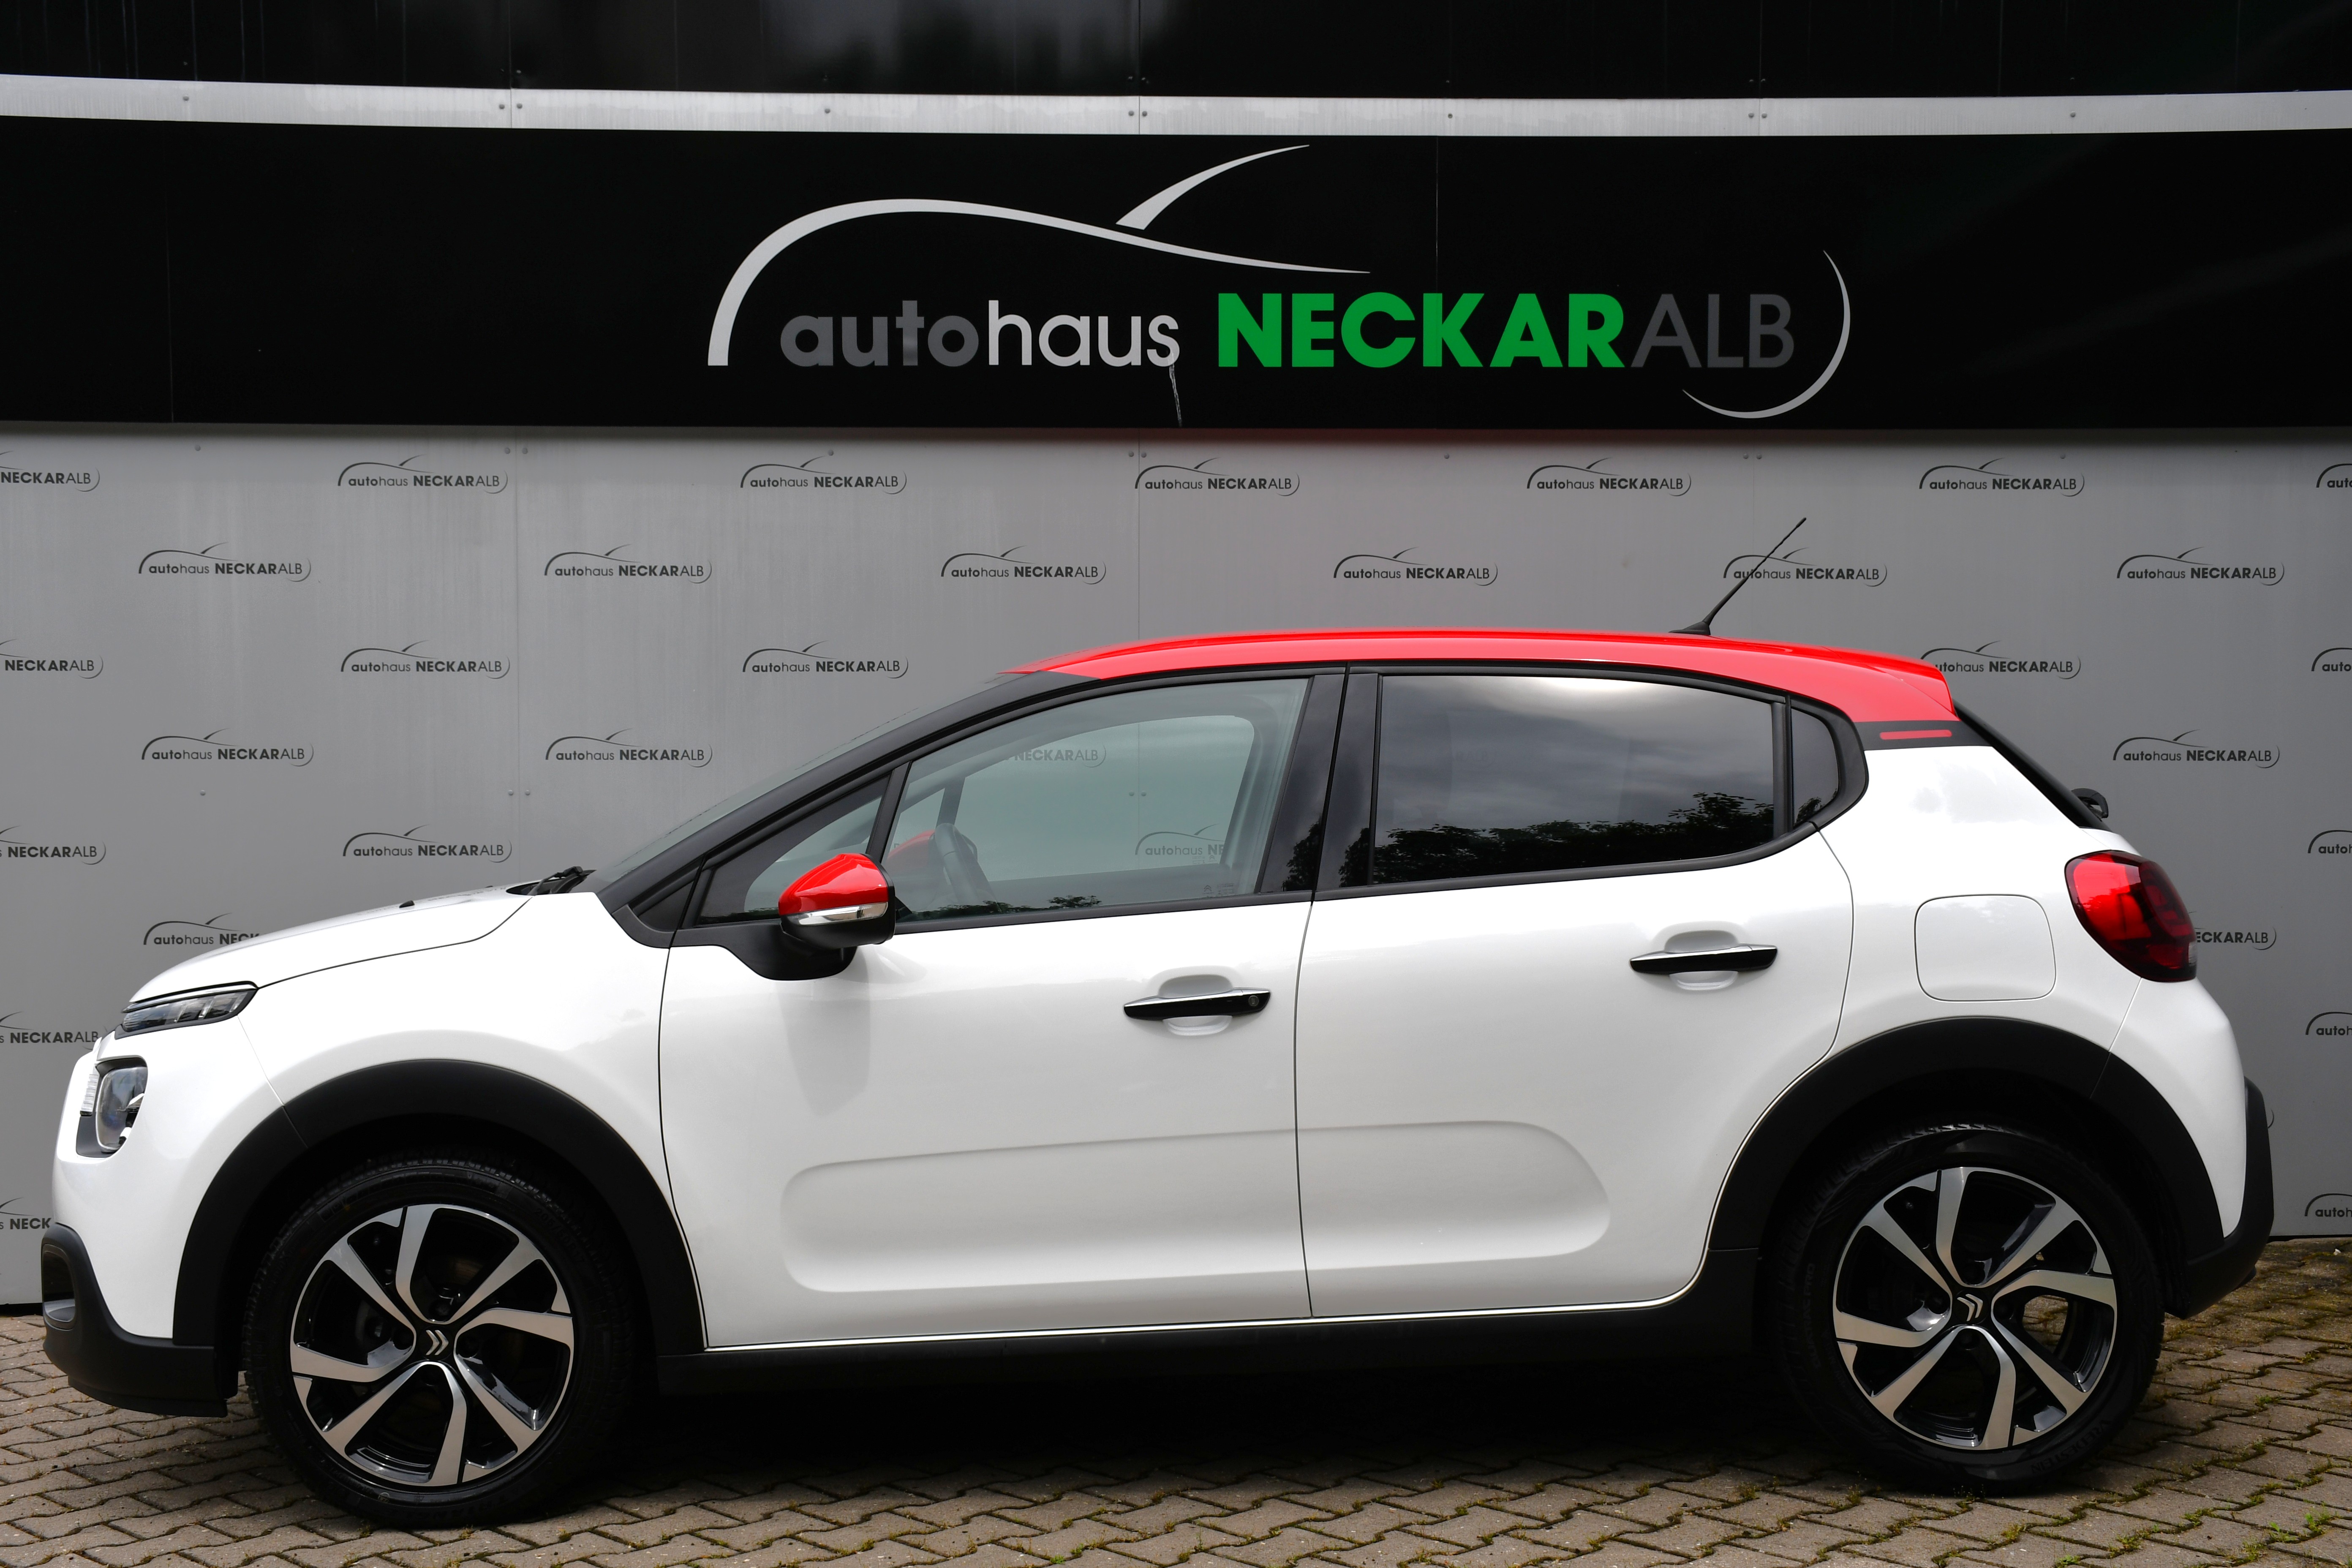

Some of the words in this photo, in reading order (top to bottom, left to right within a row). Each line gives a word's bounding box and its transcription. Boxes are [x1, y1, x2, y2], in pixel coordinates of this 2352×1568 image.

[780, 299, 1180, 368] autohaus
[1218, 291, 1794, 368] NECKARALB
[1, 471, 91, 484] NECKARALB
[348, 476, 408, 486] autohaus
[413, 475, 500, 487] NECKARALB
[749, 477, 808, 487] autohaus
[814, 476, 898, 487] NECKARALB
[1145, 479, 1203, 489] autohaus
[1208, 478, 1292, 489] NECKARALB
[1537, 479, 1595, 489] autohaus
[1600, 478, 1683, 490] NECKARALB
[1929, 479, 1987, 490] autohaus
[1992, 478, 2077, 490] NECKARALB
[149, 564, 210, 574] autohaus
[215, 563, 302, 574] NECKARALB
[555, 566, 613, 576] autohaus
[619, 565, 704, 577] NECKARALB
[951, 567, 1009, 577] autohaus
[1014, 566, 1098, 577] NECKARALB
[1343, 569, 1401, 579] autohaus
[1406, 568, 1489, 579] NECKARALB
[1796, 568, 1879, 580] NECKARALB
[2127, 569, 2186, 579] autohaus
[2191, 567, 2276, 579] NECKARALB
[5, 659, 94, 671] NECKARALB
[351, 662, 411, 672] autohaus
[416, 661, 502, 672] NECKARALB
[752, 662, 810, 672] autohaus
[816, 660, 900, 672] NECKARALB
[1989, 661, 2073, 672] NECKARALB
[152, 750, 212, 760] autohaus
[218, 748, 305, 760] NECKARALB
[556, 750, 615, 760] autohaus
[620, 749, 704, 760] NECKARALB
[2123, 751, 2181, 761] autohaus
[2186, 750, 2272, 762] NECKARALB
[8, 846, 97, 858] NECKARALB
[353, 846, 413, 856] autohaus
[418, 844, 504, 856] NECKARALB
[1145, 845, 1203, 855] autohaus
[153, 934, 214, 945] autohaus
[10, 1031, 98, 1043] NECKARALB
[2029, 1415, 2111, 1475] VREDESTEIN
